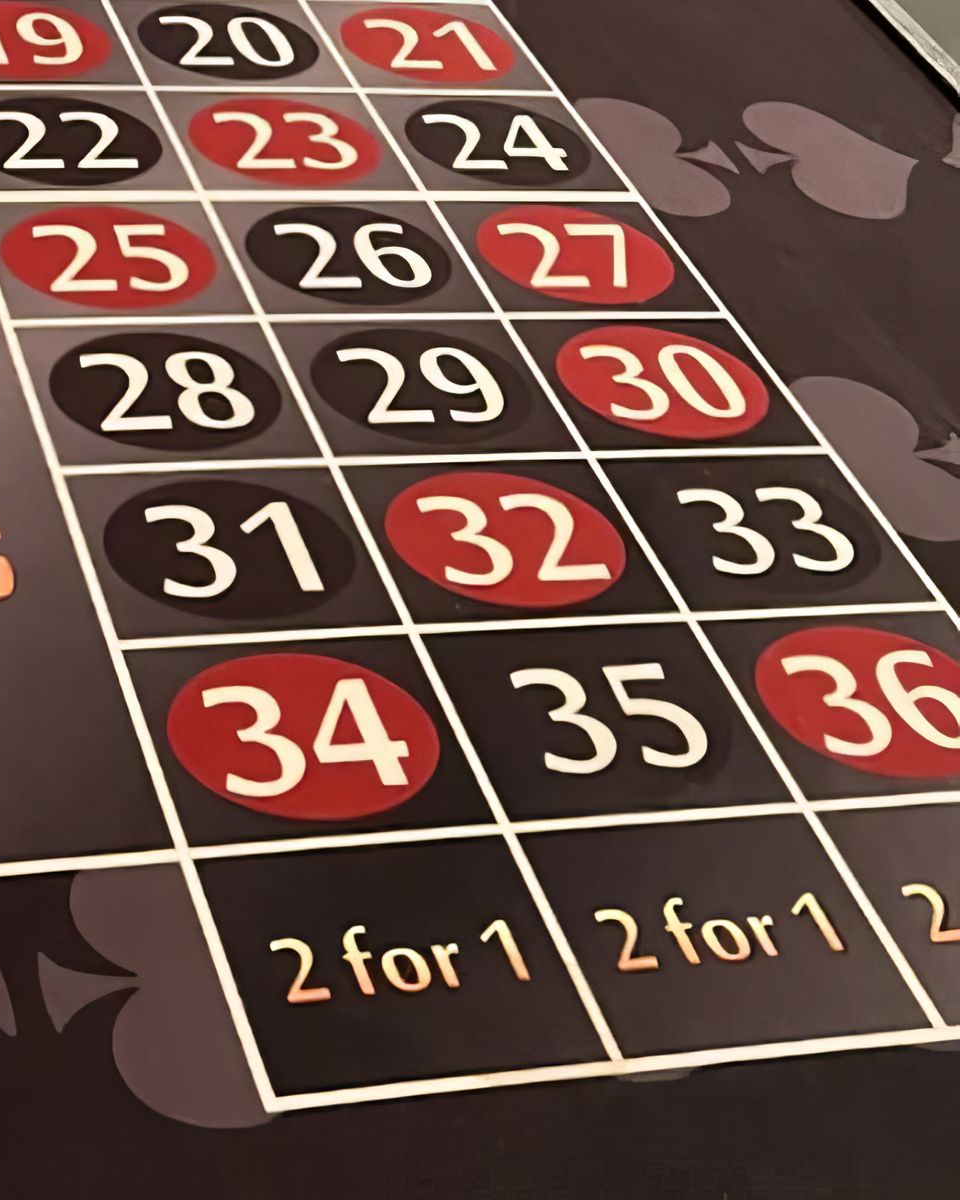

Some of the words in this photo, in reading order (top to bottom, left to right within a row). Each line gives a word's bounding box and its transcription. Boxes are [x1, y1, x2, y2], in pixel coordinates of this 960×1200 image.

[159, 16, 294, 67] 20
[363, 19, 497, 71] 21
[212, 111, 358, 170] 23
[422, 114, 569, 170] 24
[32, 224, 189, 292] 25
[274, 223, 432, 288] 26
[497, 223, 627, 288] 27
[80, 351, 254, 431] 28
[336, 347, 504, 423] 29
[580, 344, 746, 420] 30
[145, 502, 324, 597] 31
[416, 493, 611, 585] 32
[677, 487, 854, 574] 33
[202, 678, 409, 797] 34
[510, 663, 707, 774] 35
[781, 650, 960, 756] 36
[594, 909, 659, 971] 2
[663, 897, 778, 964] for
[790, 892, 844, 952] 1
[901, 883, 960, 942] 2
[270, 938, 331, 1003] 2
[342, 925, 460, 995] for
[480, 919, 531, 981] 1
